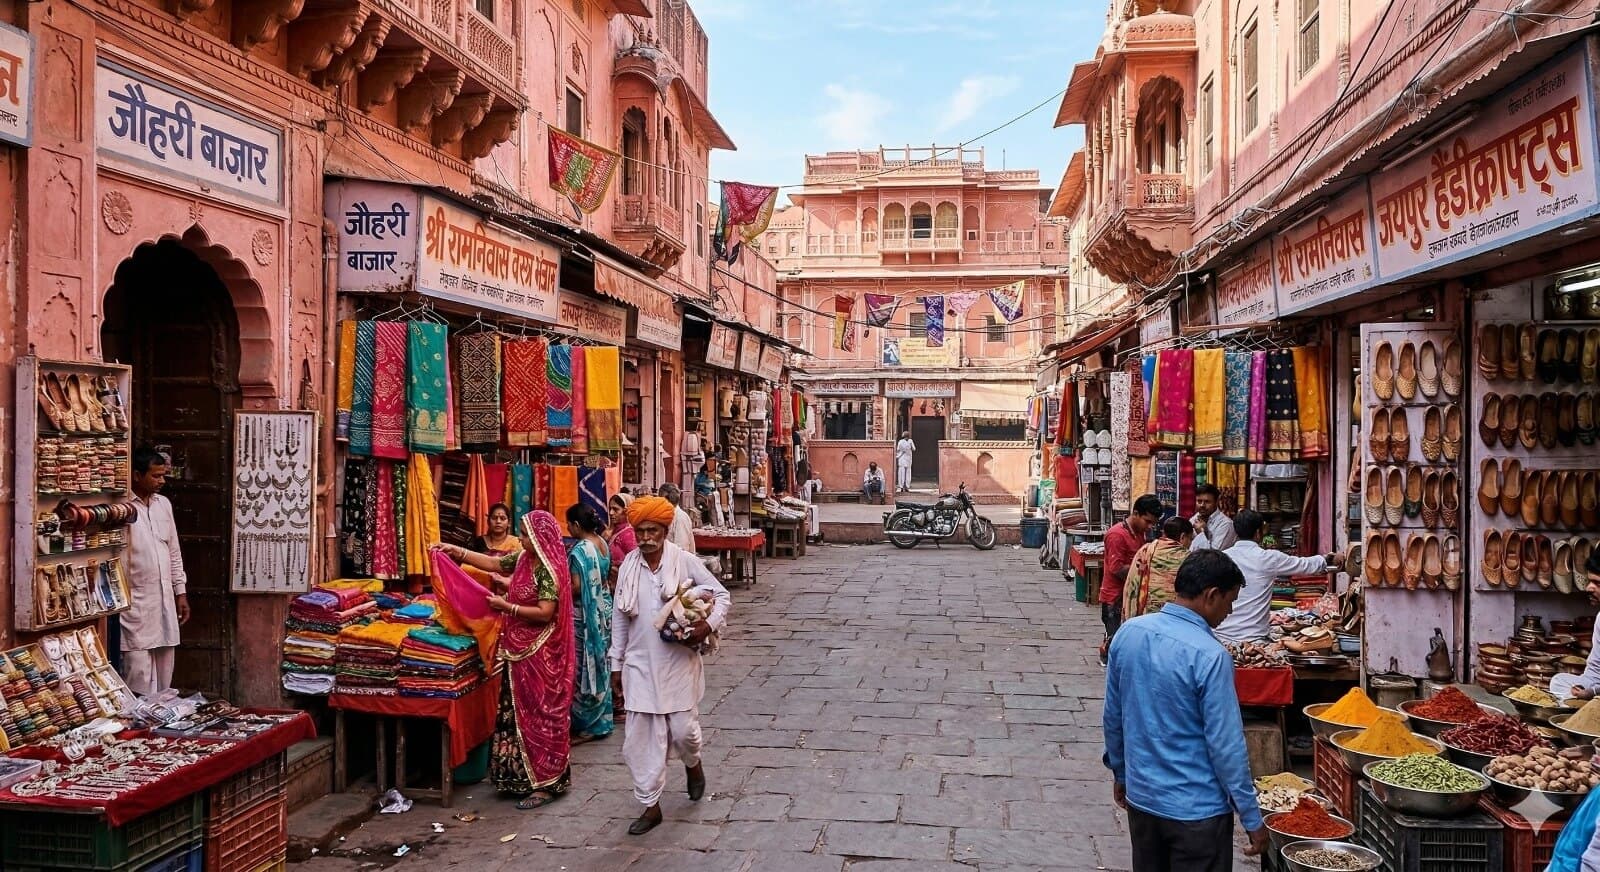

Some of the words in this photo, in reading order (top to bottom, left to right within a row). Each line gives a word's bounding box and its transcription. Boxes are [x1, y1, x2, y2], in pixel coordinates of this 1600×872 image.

[108, 83, 196, 160] जौहरी
[200, 123, 269, 186] बाज़ार
[344, 202, 410, 240] जौहरी
[425, 206, 447, 261] श्री
[448, 221, 511, 280] रामनिवास
[1278, 236, 1295, 287] श्री
[1296, 209, 1366, 278] रामनिवास
[1376, 175, 1429, 251] जयपुर
[347, 251, 398, 274] बाजार
